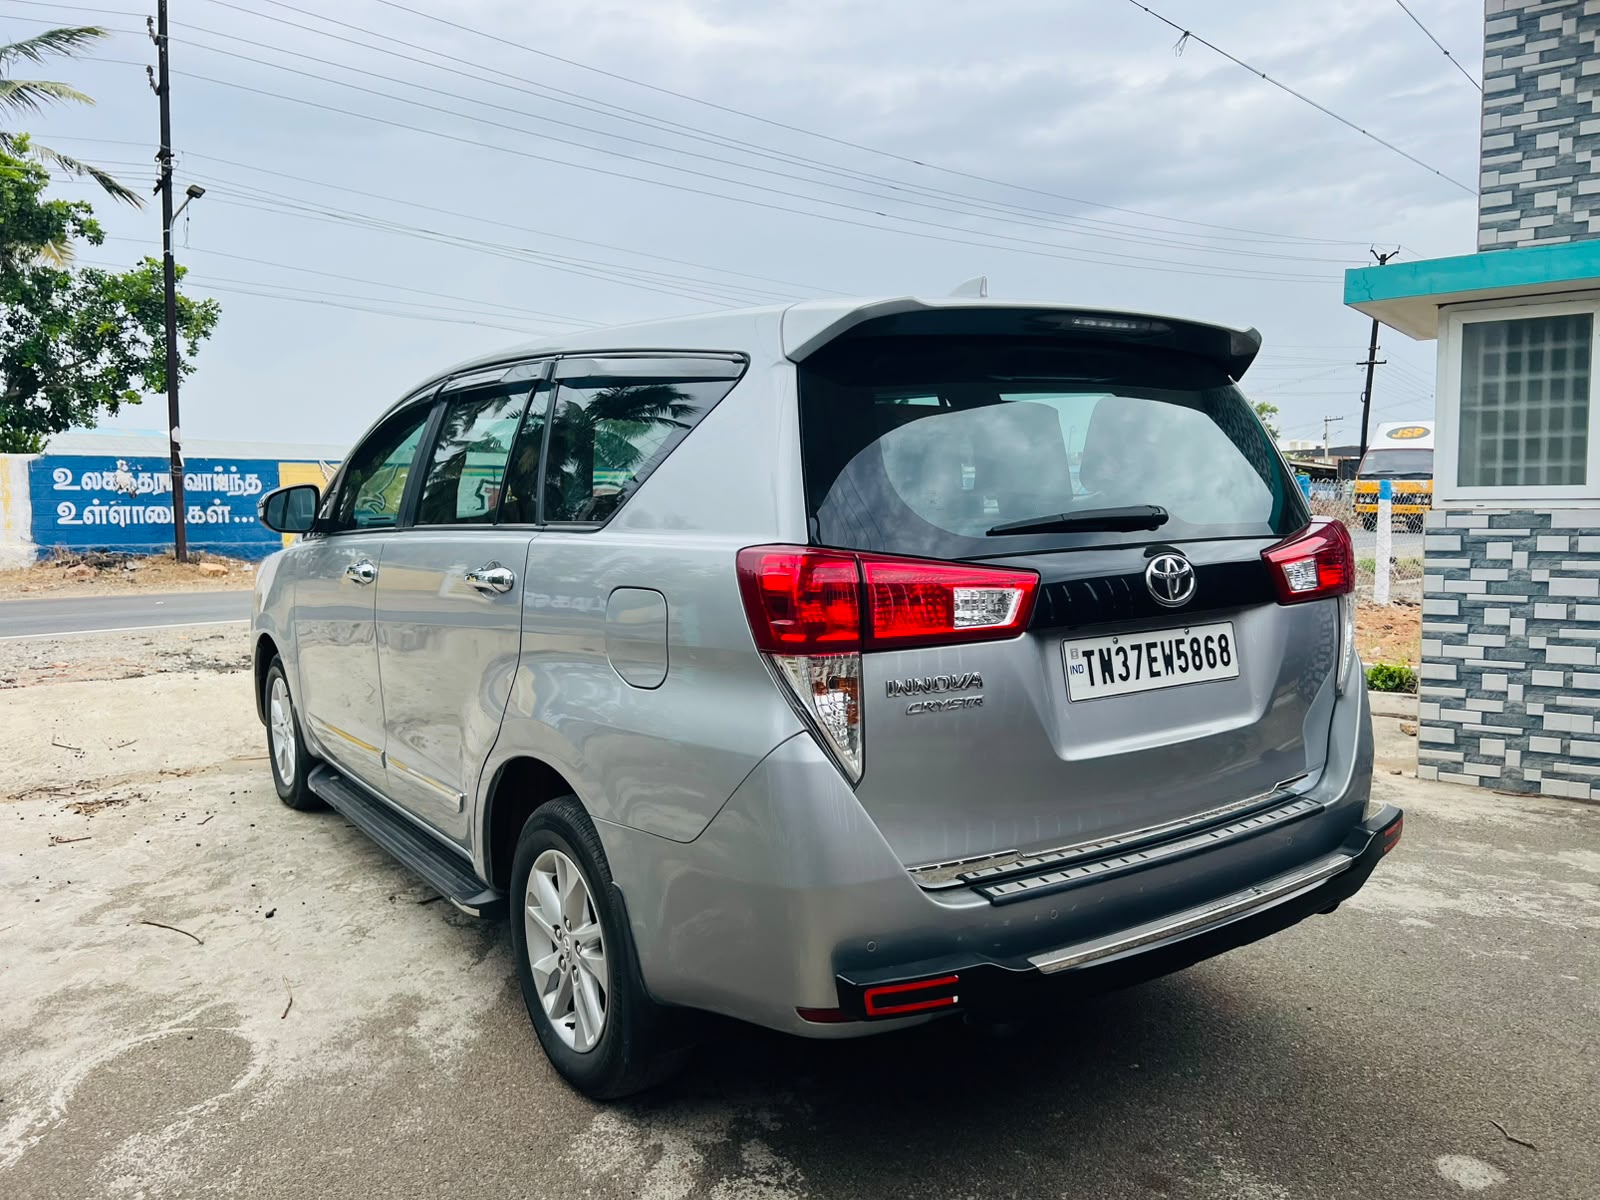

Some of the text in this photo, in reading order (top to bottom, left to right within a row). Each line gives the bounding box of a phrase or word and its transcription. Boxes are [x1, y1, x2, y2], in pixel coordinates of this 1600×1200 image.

[1069, 663, 1084, 675] IND
[1082, 633, 1231, 686] TN37EW5868
[886, 671, 983, 698] INNOVA
